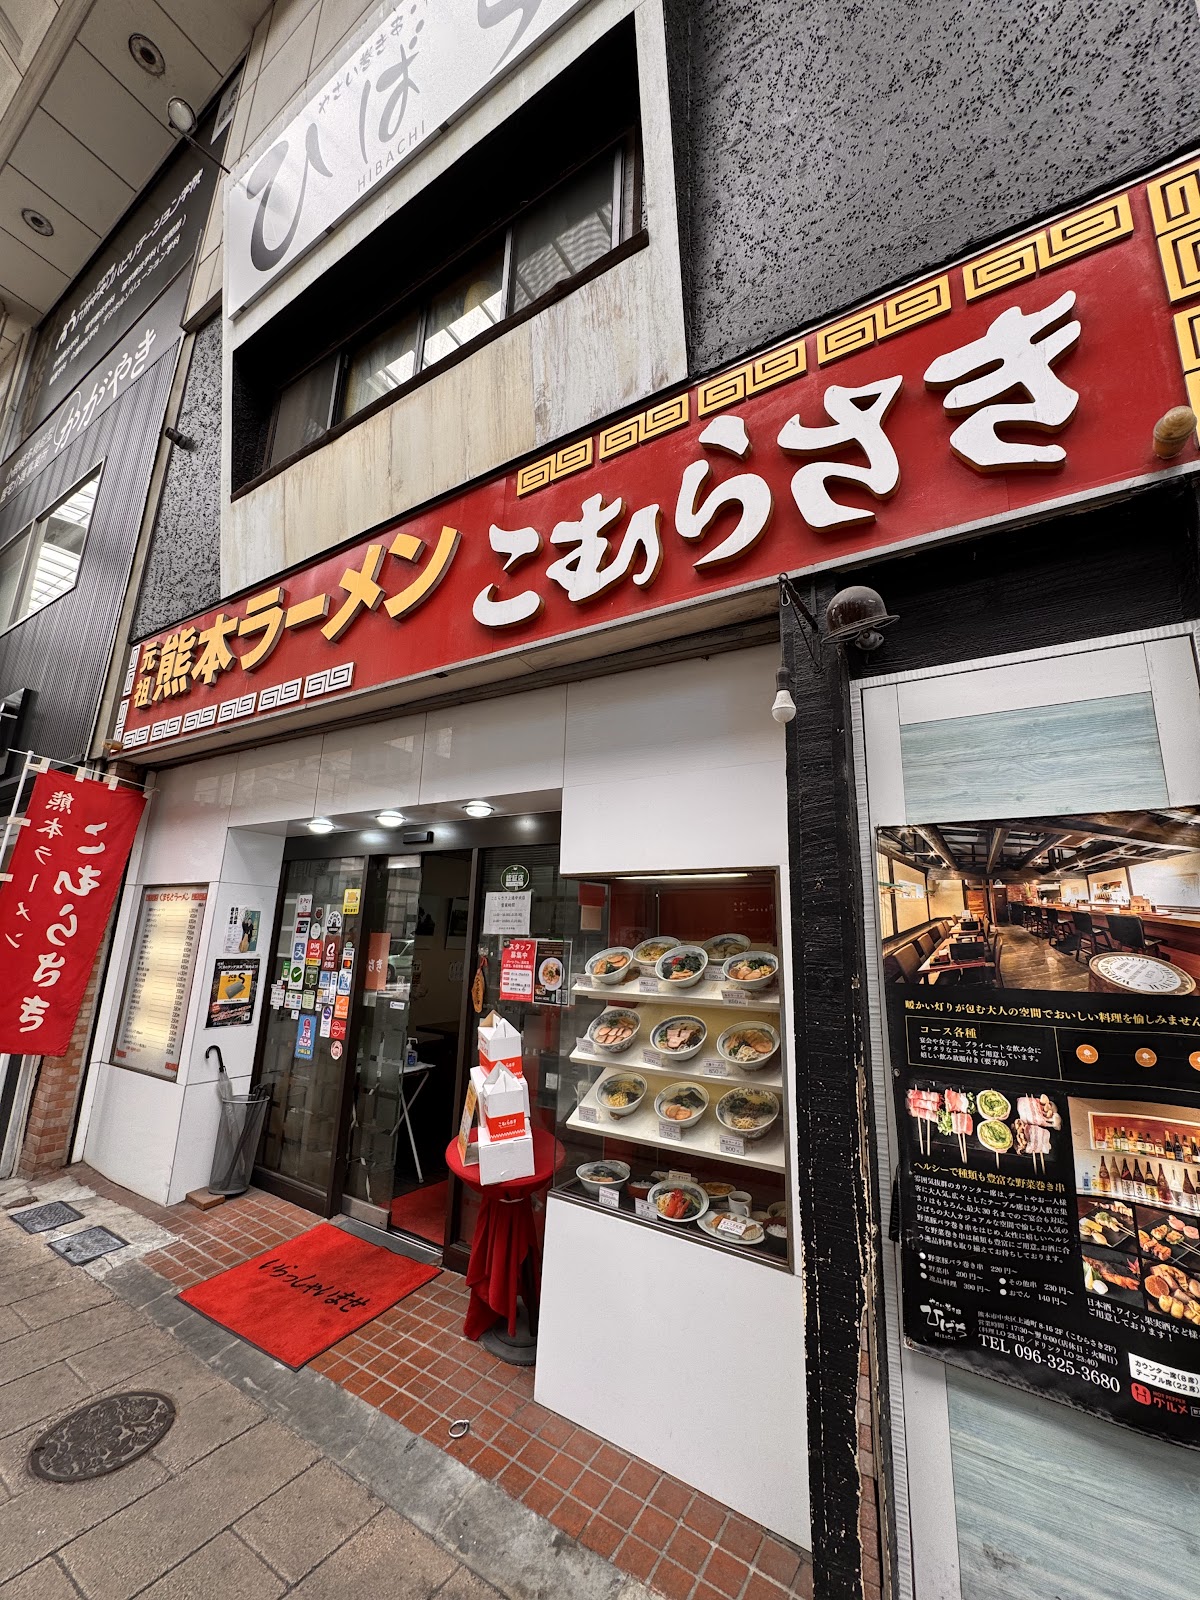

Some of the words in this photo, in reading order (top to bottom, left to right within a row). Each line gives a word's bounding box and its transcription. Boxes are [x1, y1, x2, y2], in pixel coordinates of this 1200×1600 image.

[319, 15, 403, 114] やさい巻き串
[356, 119, 427, 193] HIBACHI
[152, 526, 463, 702] 熊本ラーメン
[472, 289, 1083, 629] こむらさき
[133, 640, 161, 709] 元祖
[509, 943, 532, 951] スタッフ
[510, 951, 528, 959] 募集中
[920, 1025, 978, 1039] コース各種
[914, 1162, 1066, 1193] ヘルシーで種類も豊富な野菜巻き串
[258, 1258, 371, 1313] いらっしゃいませ
[1009, 1289, 1031, 1299] おでん
[920, 1304, 967, 1337] ひばち
[1087, 1297, 1200, 1340] 日本酒、ワイン、果実酒など様
[977, 1333, 1011, 1354] TEL
[1014, 1343, 1121, 1393] 096-325-3680
[1152, 1390, 1165, 1400] HOT
[1153, 1396, 1189, 1415] グルメ
